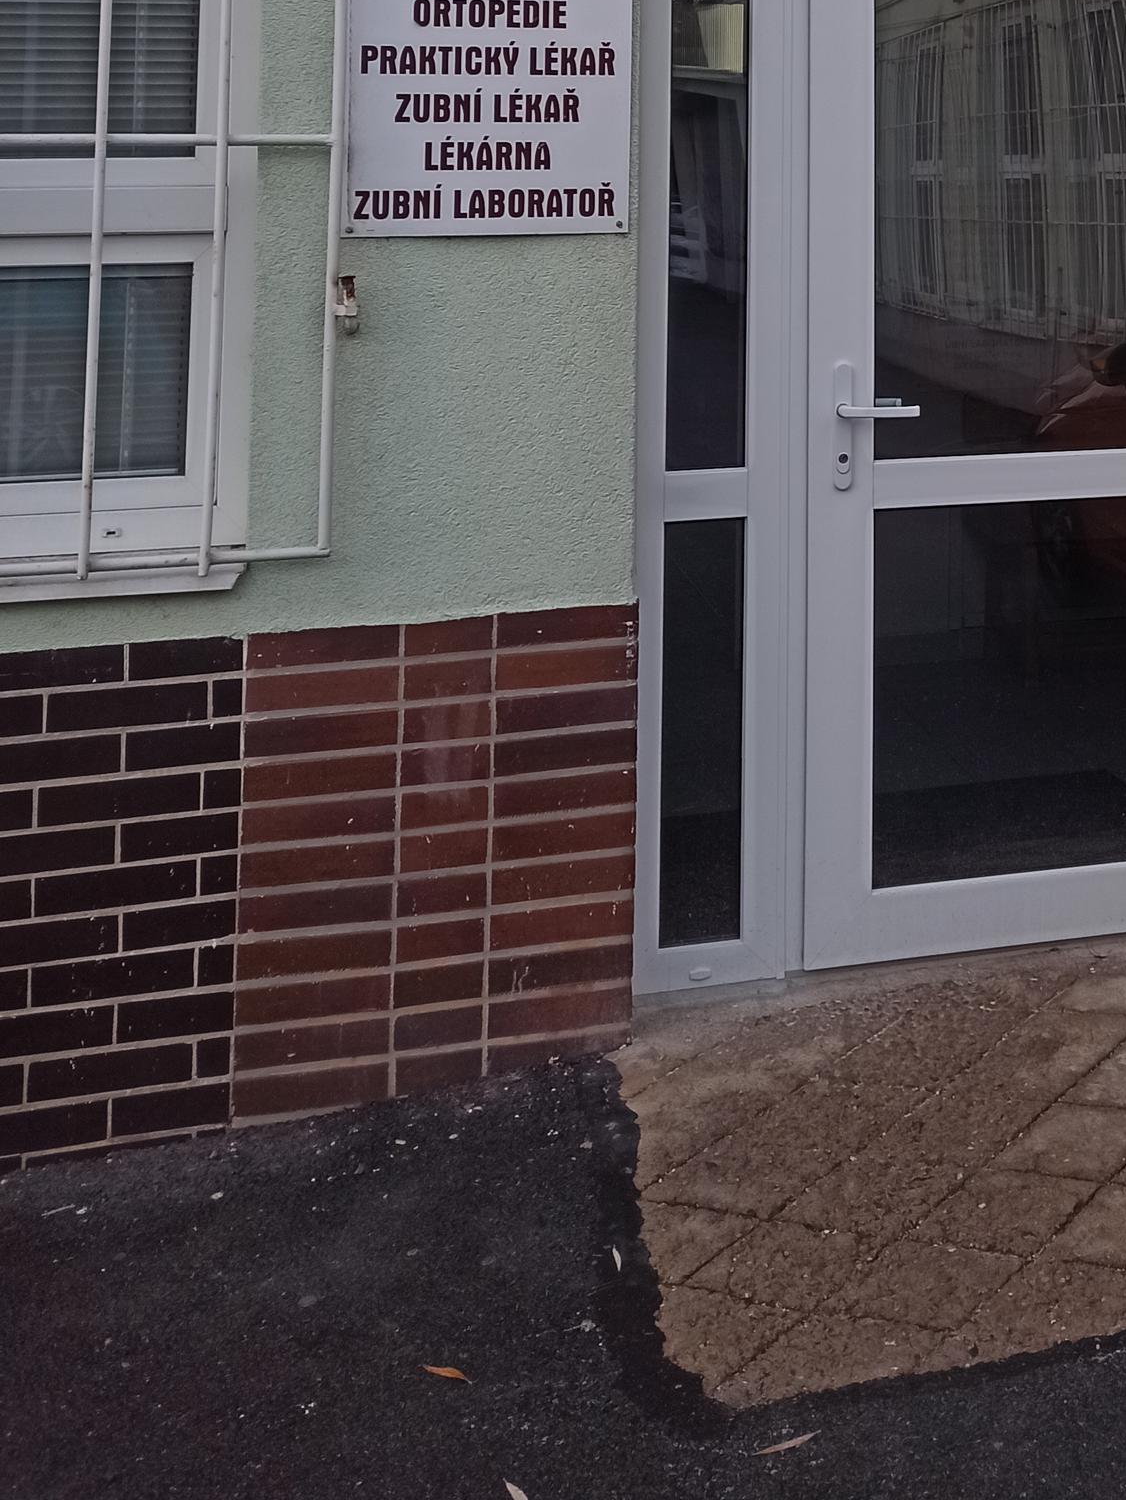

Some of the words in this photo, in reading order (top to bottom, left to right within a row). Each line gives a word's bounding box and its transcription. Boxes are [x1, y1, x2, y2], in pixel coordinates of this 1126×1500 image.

[361, 41, 519, 75] PRAKTICKÝ
[530, 42, 615, 75] LÉKAŘ
[395, 88, 482, 122] ZUBNÍ
[494, 88, 579, 122] LÉKAŘ
[425, 136, 550, 170] LÉKÁRNA
[354, 184, 441, 219] ZUBNÍ
[454, 182, 614, 218] LABORATOŘ
